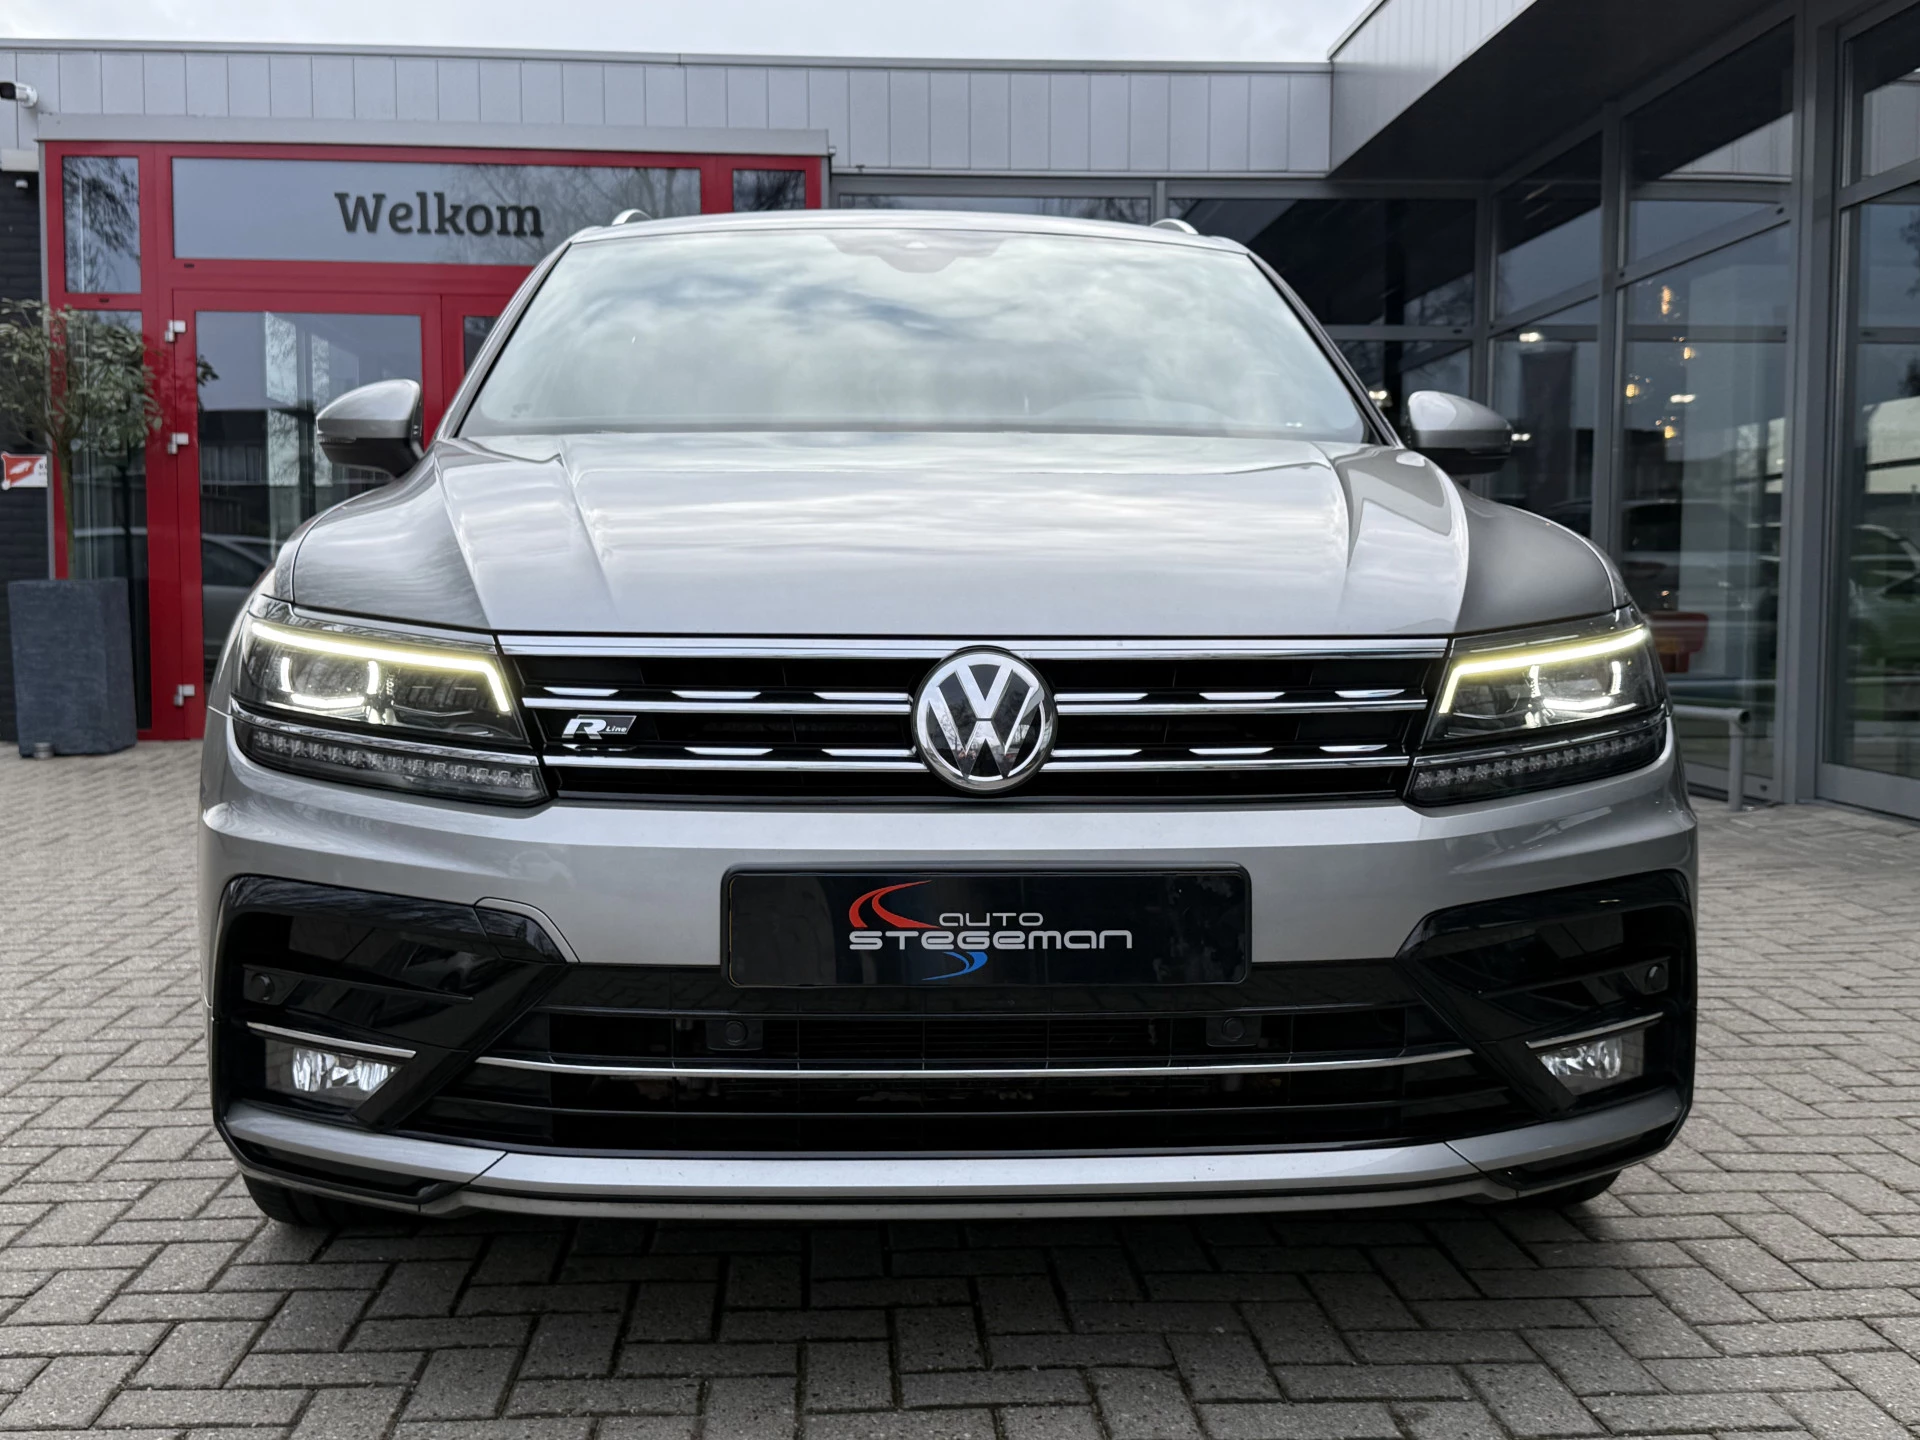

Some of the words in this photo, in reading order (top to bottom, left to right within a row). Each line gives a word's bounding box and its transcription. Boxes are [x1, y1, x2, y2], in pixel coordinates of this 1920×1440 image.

[334, 191, 544, 237] Welkom
[561, 718, 603, 740] R
[605, 725, 628, 733] Line
